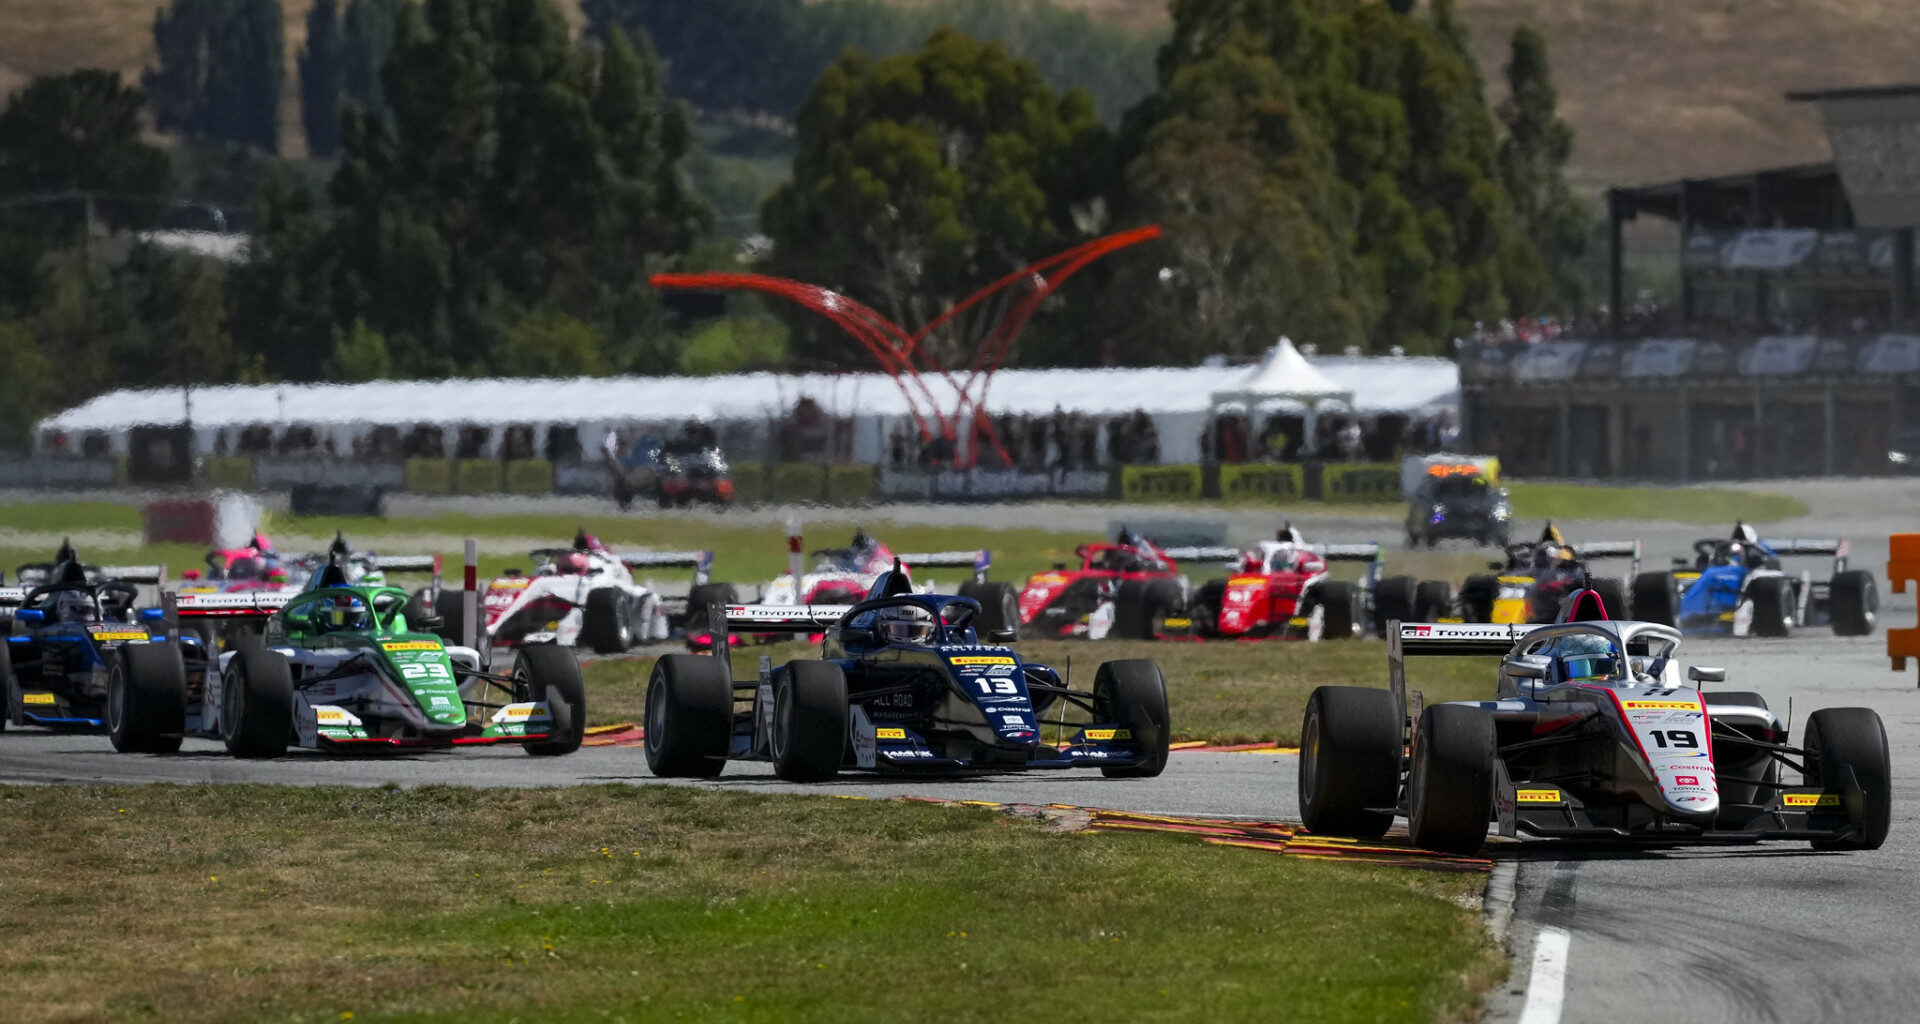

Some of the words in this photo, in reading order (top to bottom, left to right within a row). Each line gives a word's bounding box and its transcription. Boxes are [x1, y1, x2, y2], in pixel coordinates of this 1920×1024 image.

[1401, 625, 1431, 638] GR
[1435, 629, 1501, 637] TOYOTA
[399, 662, 450, 679] 23
[974, 677, 1018, 694] 13
[893, 693, 913, 707] ROAD
[1648, 730, 1699, 748] 19
[1670, 764, 1711, 772] Castrol
[1786, 796, 1836, 804] PIRELLI
